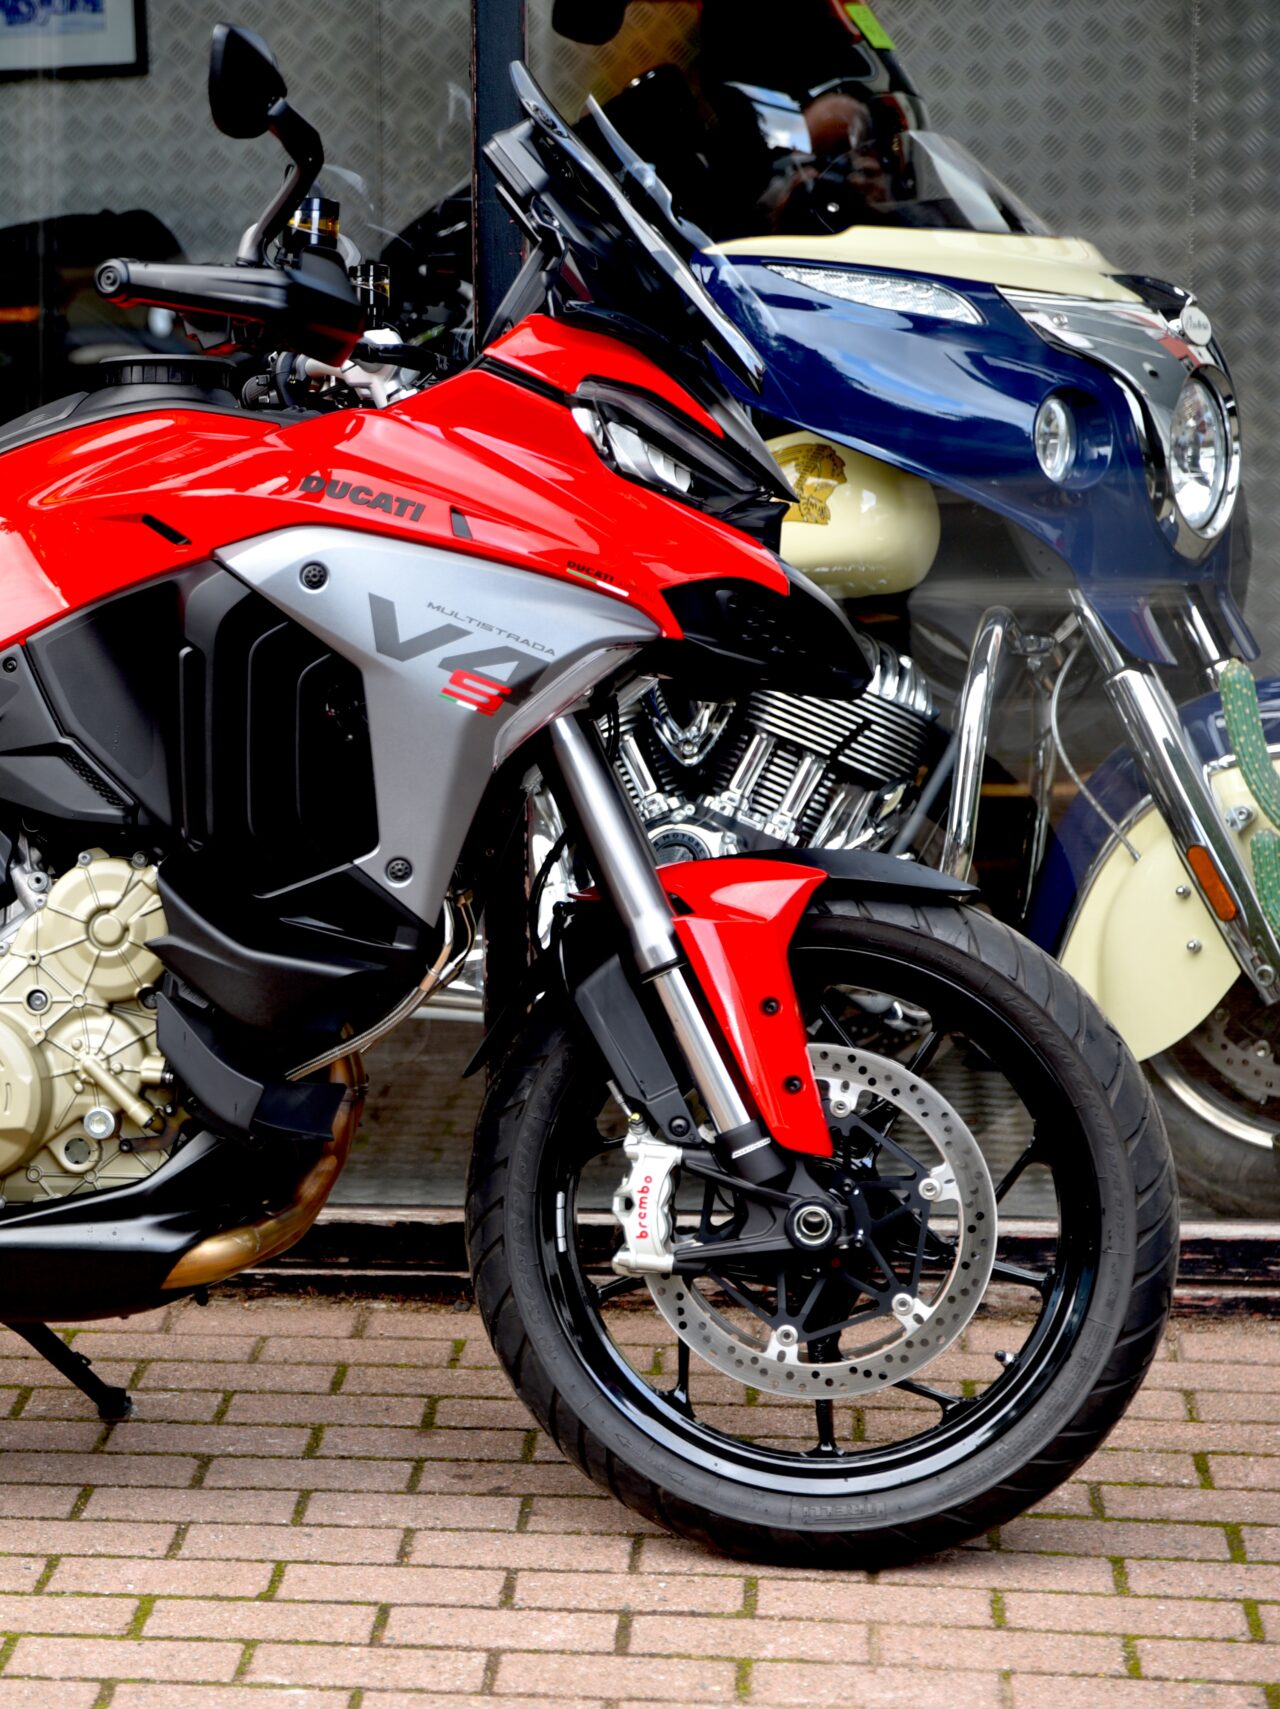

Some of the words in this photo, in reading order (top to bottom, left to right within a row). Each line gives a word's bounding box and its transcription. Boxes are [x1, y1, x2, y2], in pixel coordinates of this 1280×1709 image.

[299, 475, 426, 522] DUCATI
[566, 560, 615, 584] DUCATI
[368, 591, 552, 707] V4
[426, 601, 557, 657] MULTISTRADA
[440, 668, 512, 714] S
[636, 1175, 653, 1239] brembo
